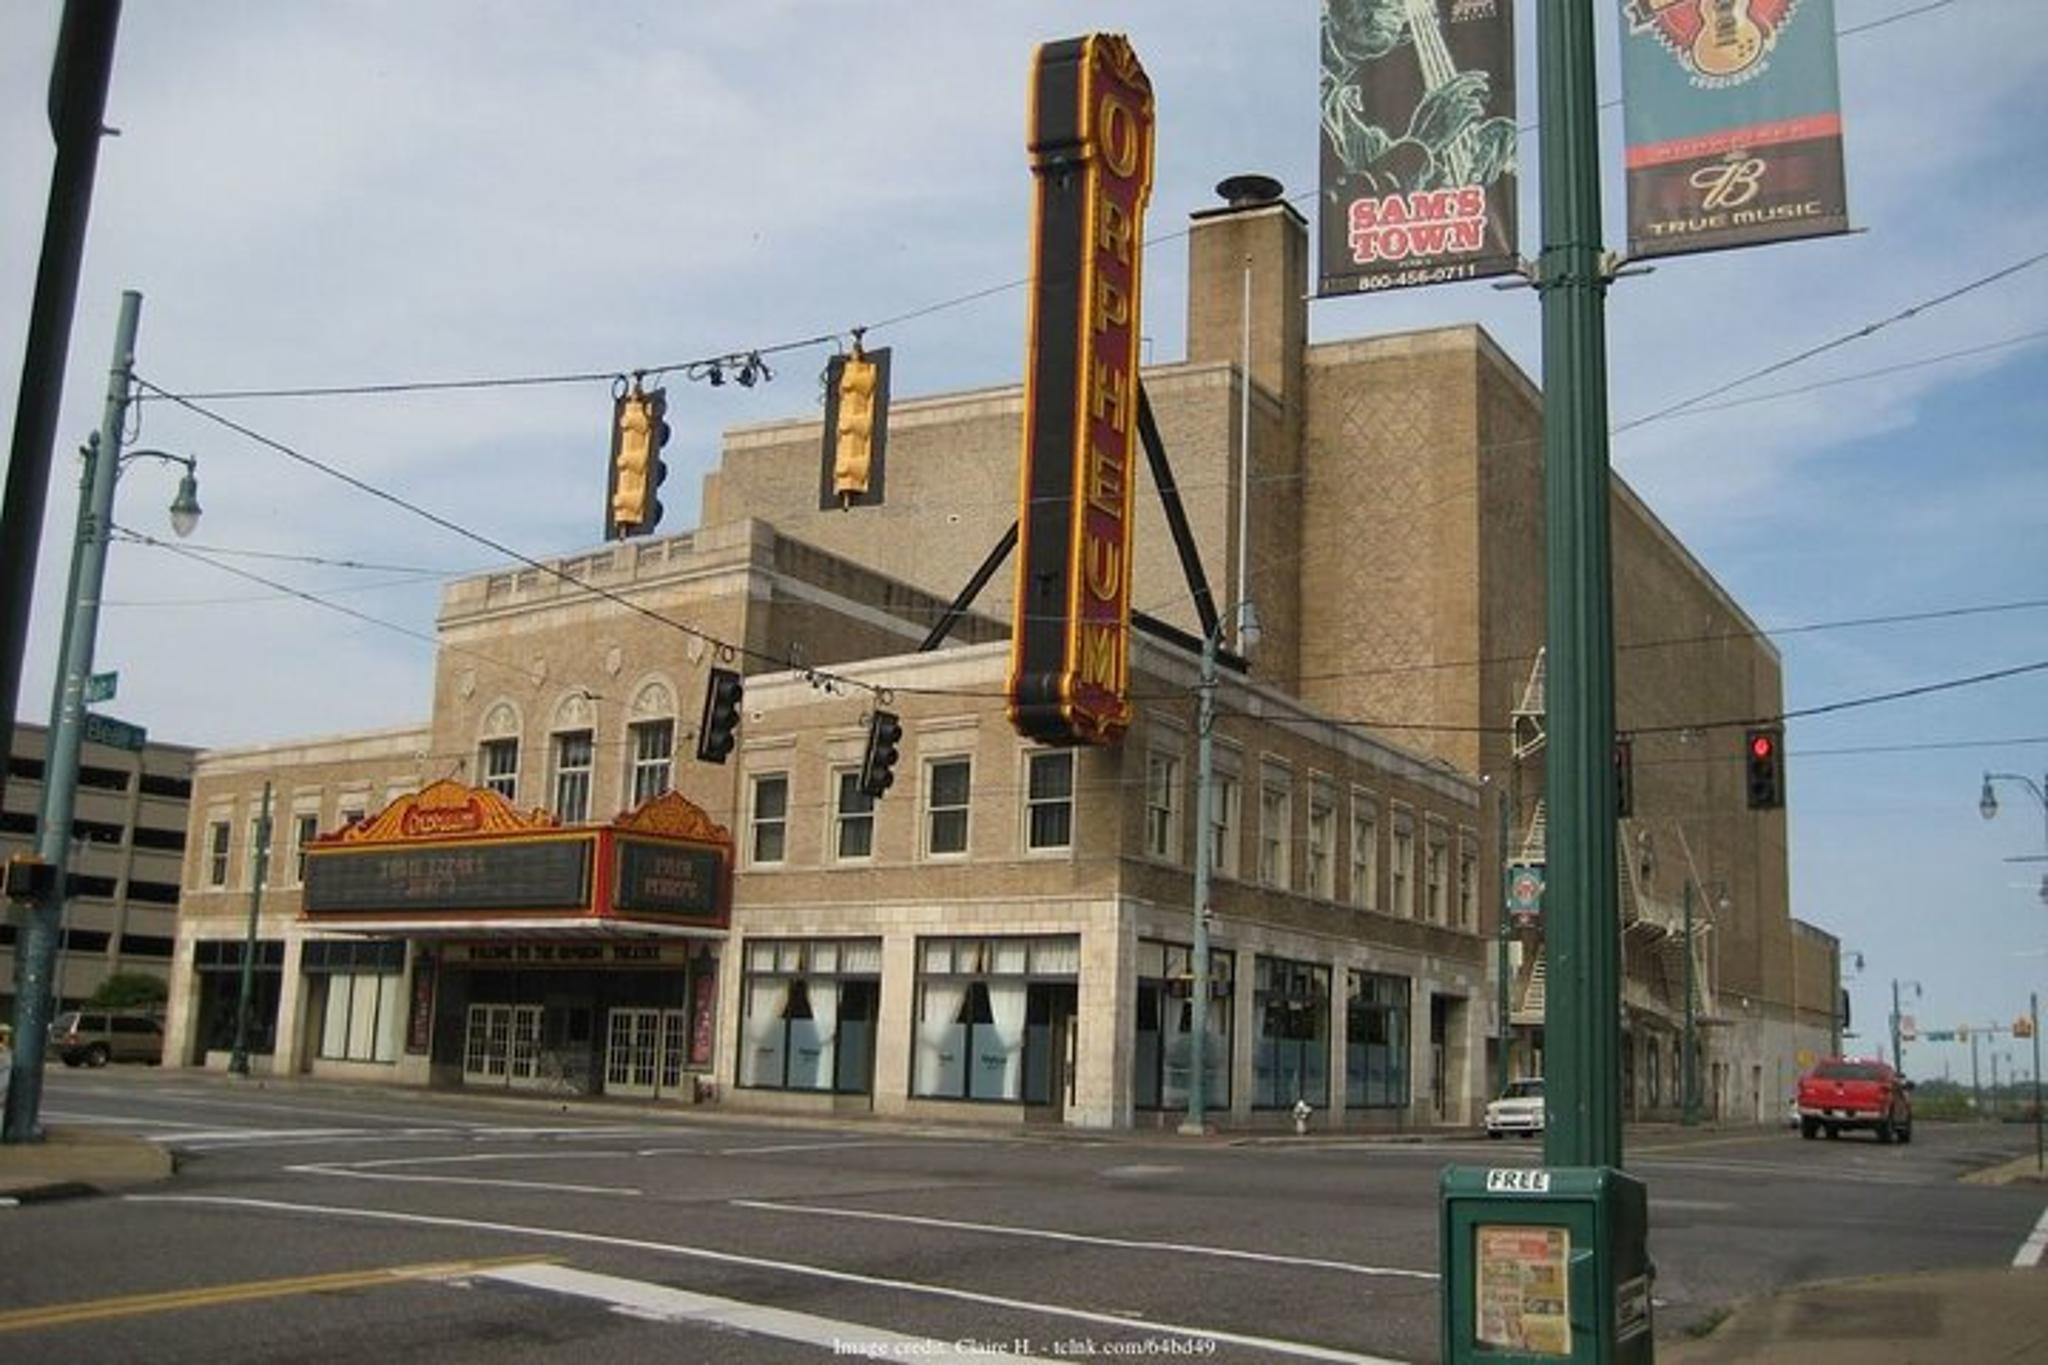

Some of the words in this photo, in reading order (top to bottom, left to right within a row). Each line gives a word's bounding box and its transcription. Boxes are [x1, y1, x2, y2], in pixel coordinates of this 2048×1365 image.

[1650, 217, 1728, 236] TRUE
[1732, 201, 1823, 224] MUSIC
[1350, 218, 1487, 263] TOWN
[1359, 263, 1475, 291] 800-456-0711
[1084, 93, 1138, 692] ORPHEUM
[1490, 1170, 1544, 1189] FREE
